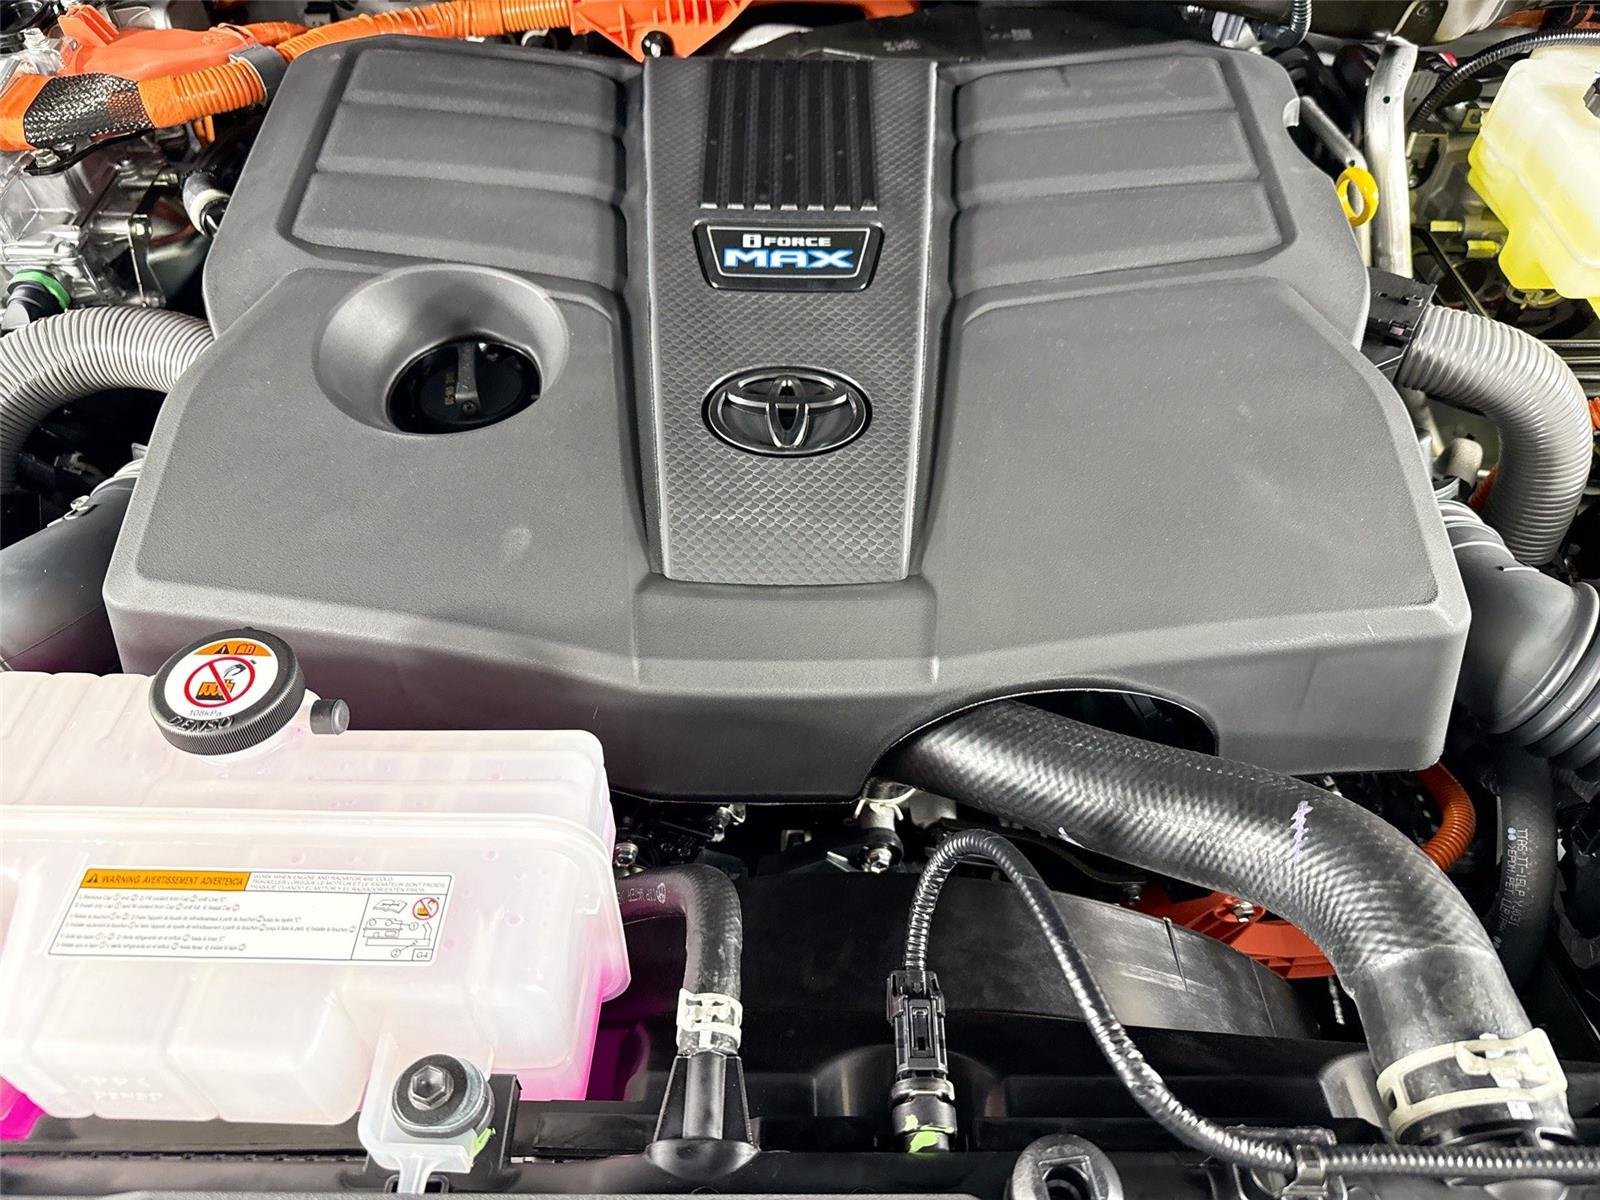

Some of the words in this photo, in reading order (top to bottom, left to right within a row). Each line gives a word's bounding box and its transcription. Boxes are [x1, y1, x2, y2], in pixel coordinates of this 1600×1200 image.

[764, 236, 832, 247] FORCE
[723, 248, 854, 269] MAX
[189, 709, 223, 718] 108kPa
[168, 715, 235, 733] DENSO
[102, 875, 141, 884] WARNING
[142, 876, 199, 886] AVERTISSEMENT
